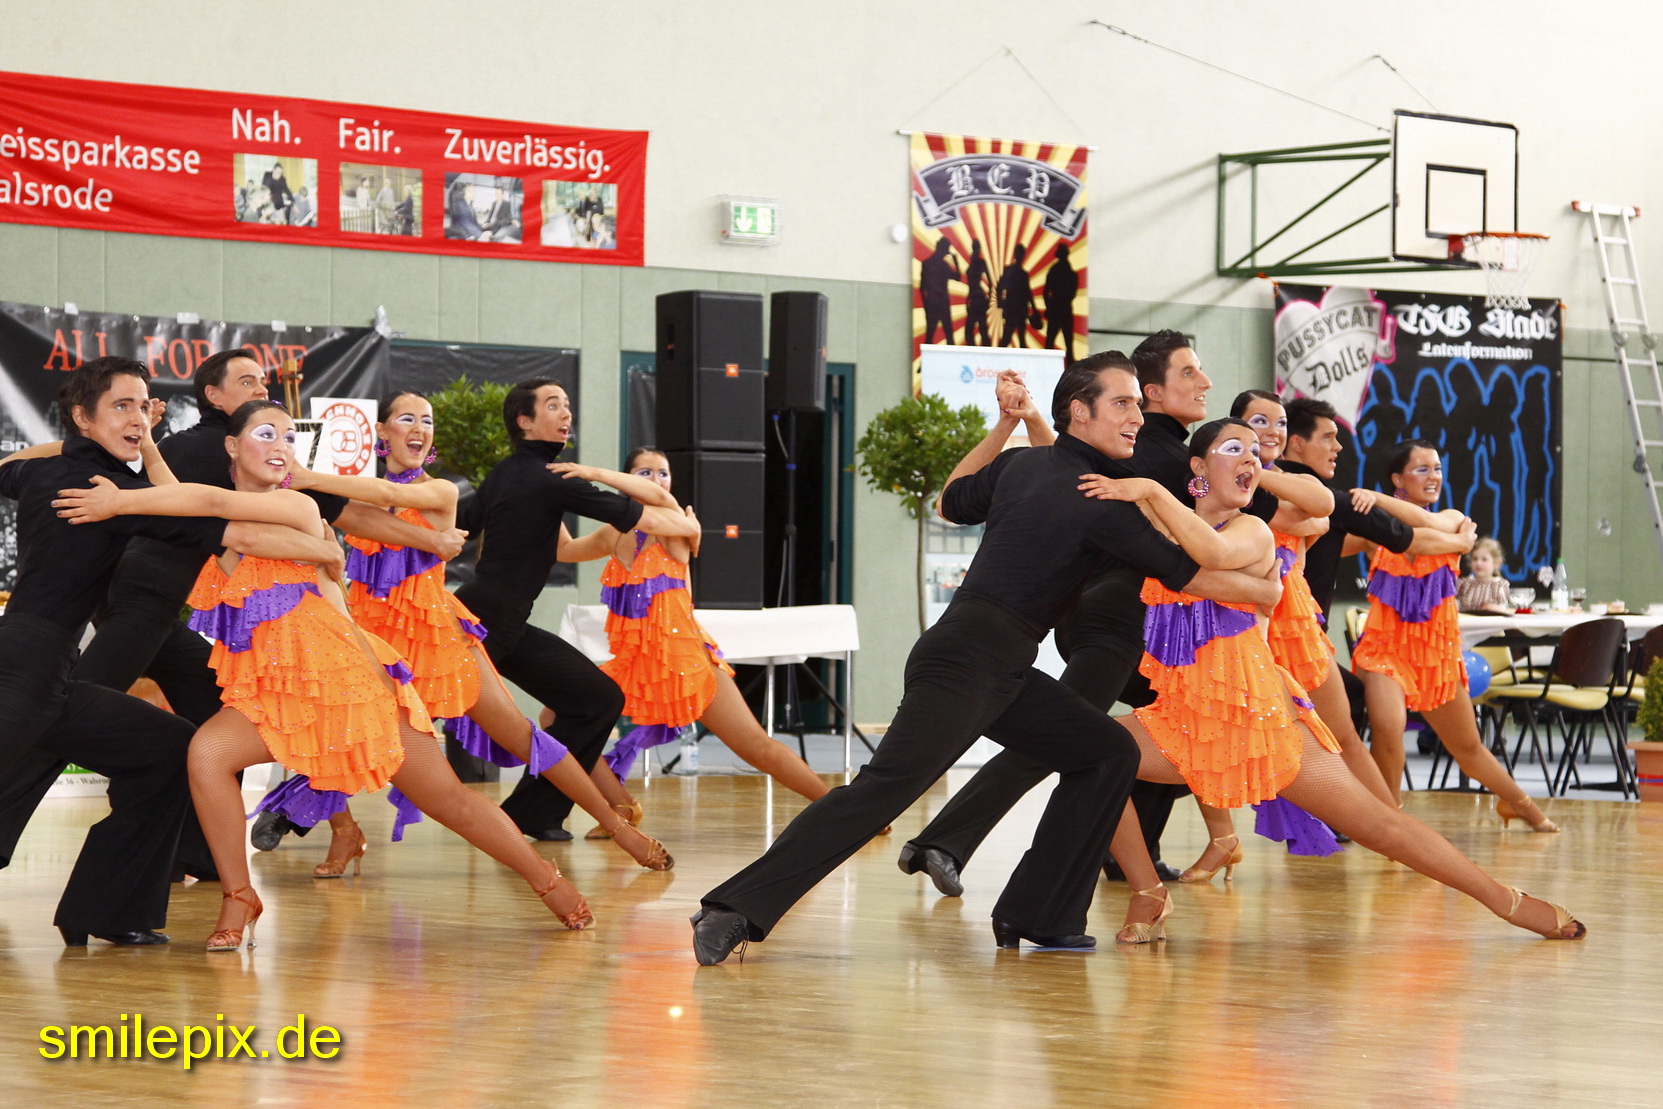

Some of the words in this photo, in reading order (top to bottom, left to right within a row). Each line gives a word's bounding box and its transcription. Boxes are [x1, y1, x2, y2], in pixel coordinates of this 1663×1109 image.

[0, 127, 200, 173] eissparkasse
[231, 108, 301, 145] Nah.
[338, 117, 402, 154] Fair.
[443, 128, 611, 179] Zuverlässig.
[0, 171, 113, 212] alsrode
[1277, 304, 1379, 372] PUSSYCAT
[1478, 308, 1558, 341] Stade
[1305, 344, 1370, 393] Dolls
